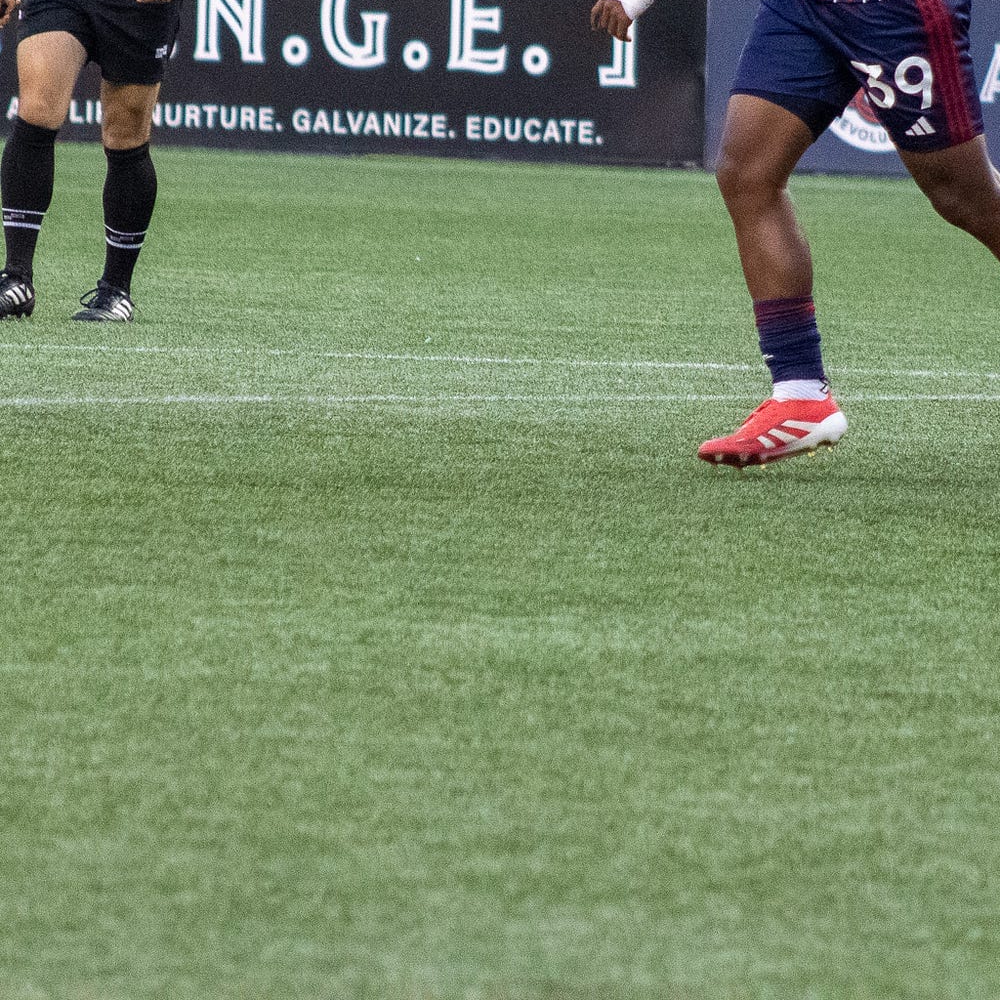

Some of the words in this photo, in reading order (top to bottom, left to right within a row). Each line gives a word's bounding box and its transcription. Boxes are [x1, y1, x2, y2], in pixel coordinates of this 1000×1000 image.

[850, 55, 933, 110] 39
[152, 102, 282, 133] NURTURE.
[292, 107, 456, 140] GALVANIZE.
[465, 114, 604, 146] EDUCATE.
